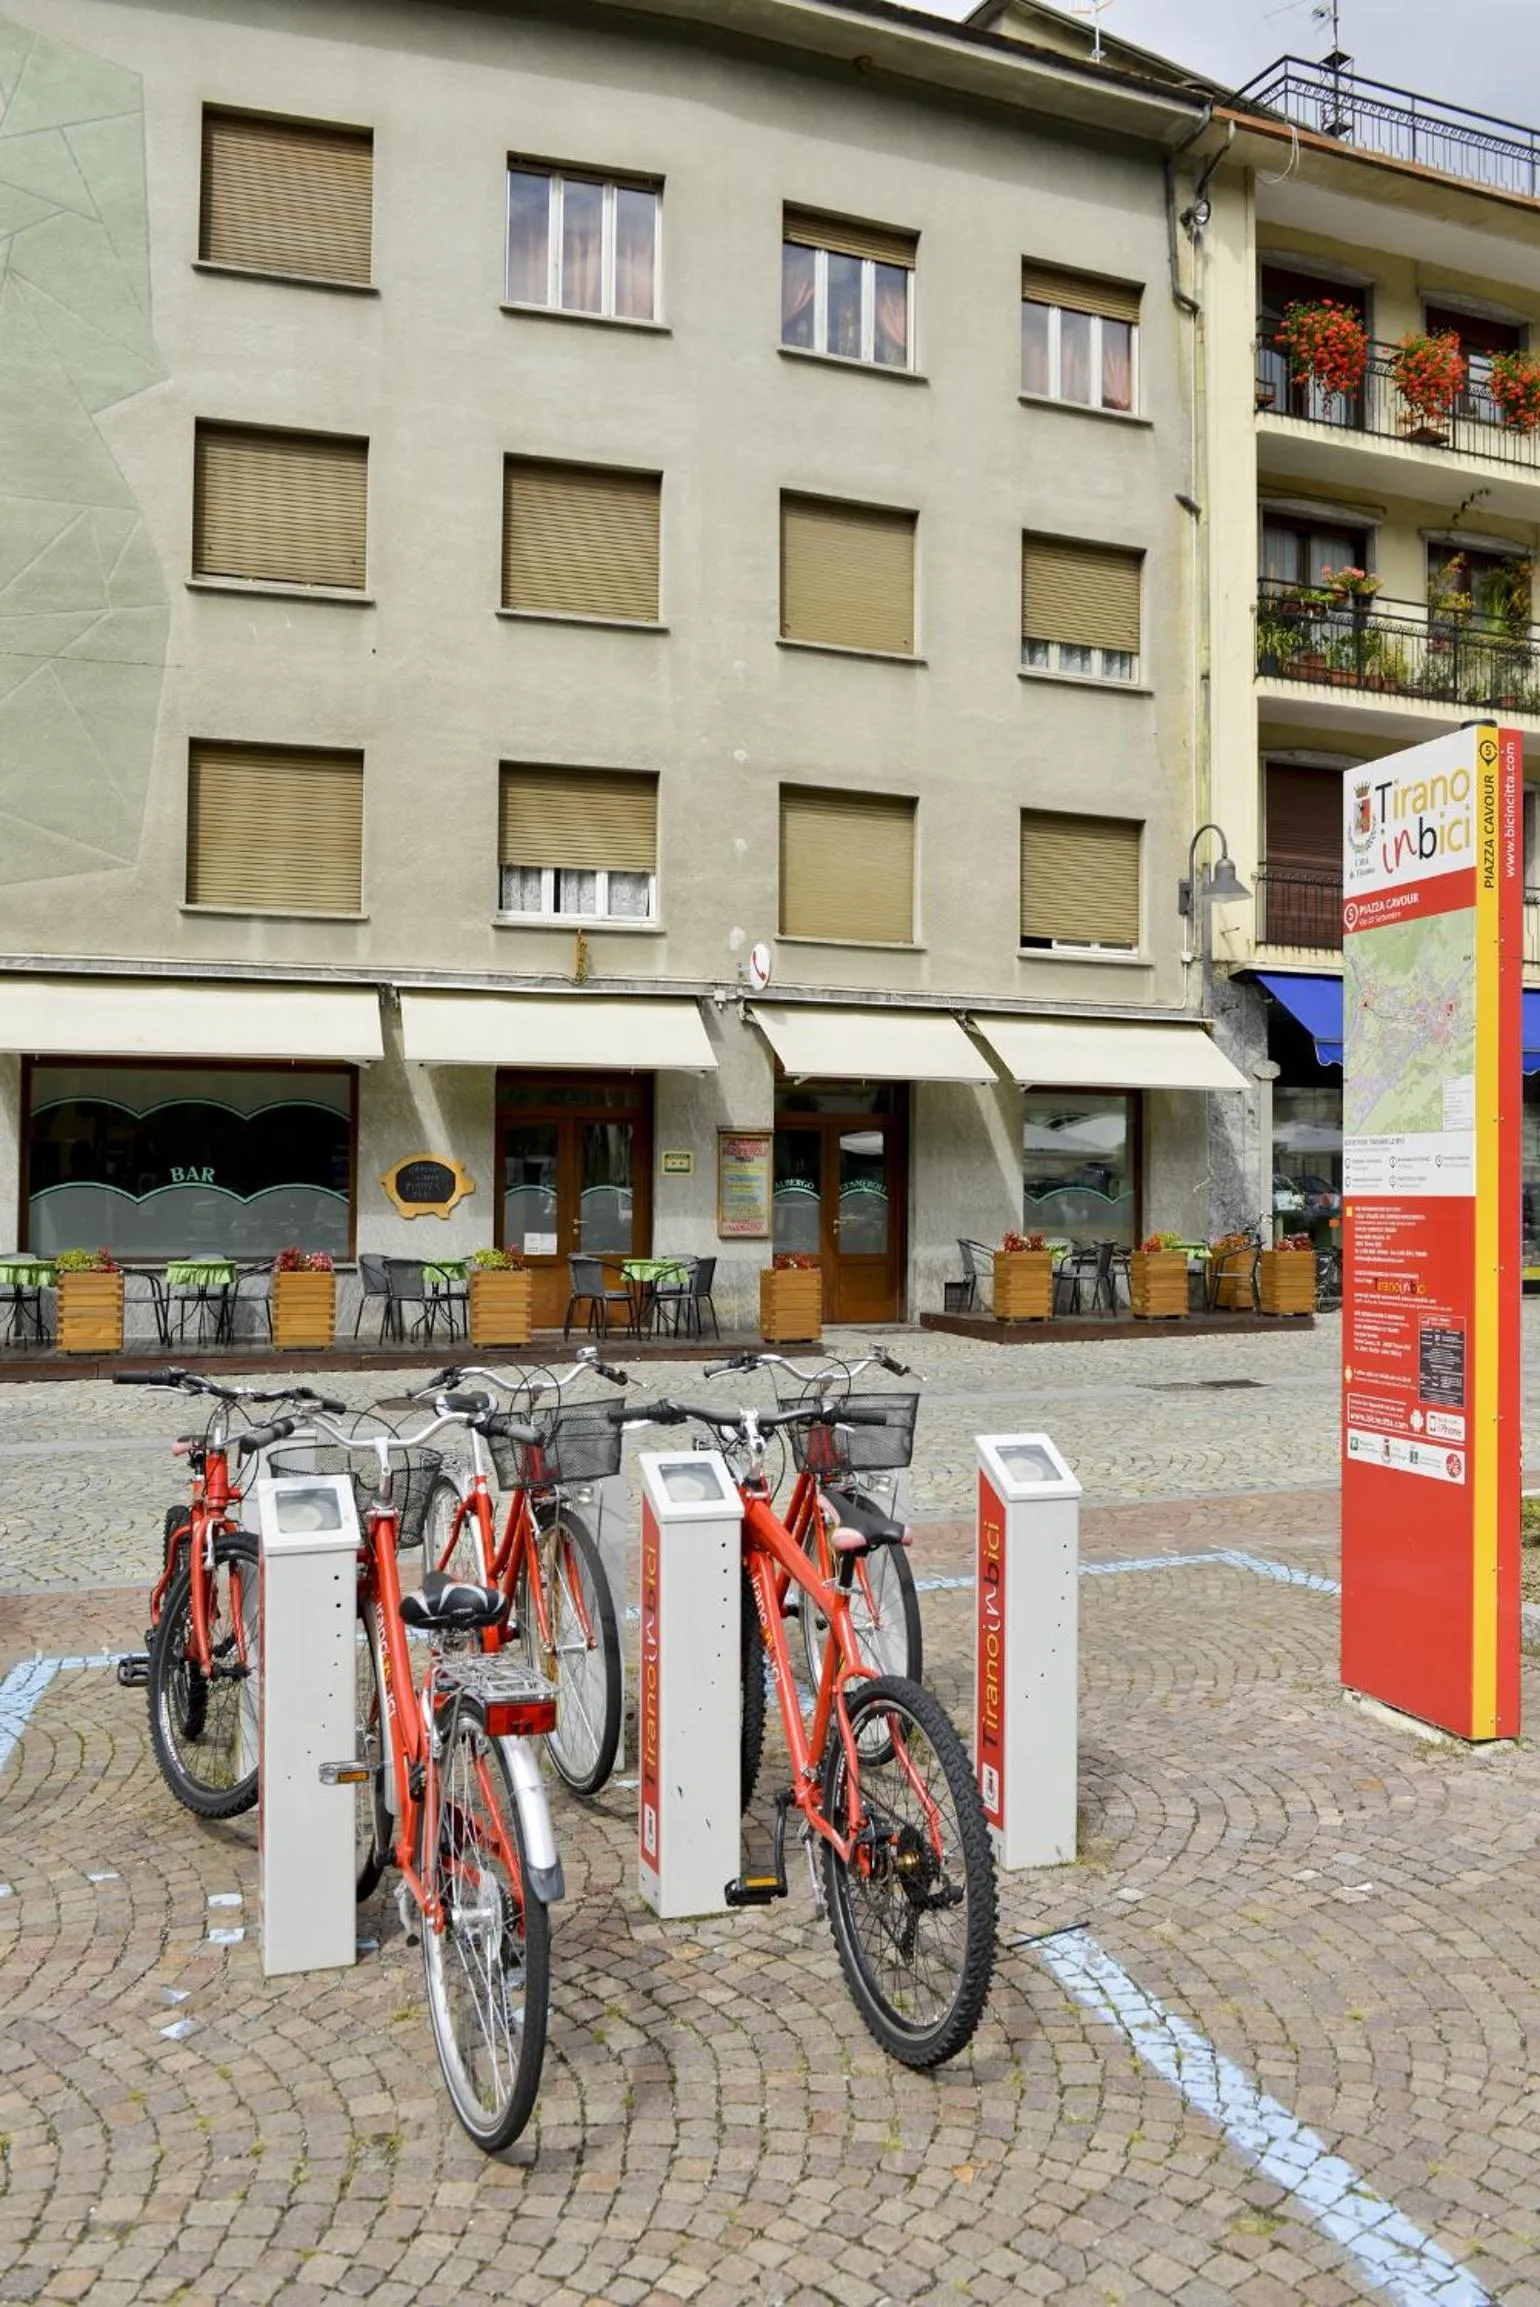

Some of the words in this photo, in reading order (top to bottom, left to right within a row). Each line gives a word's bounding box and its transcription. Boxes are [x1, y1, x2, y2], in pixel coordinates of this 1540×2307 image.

[1375, 768, 1470, 823] Tirano
[1484, 774, 1495, 835] CAVOUR
[1504, 742, 1516, 878] www.bicincitta.com
[1484, 838, 1495, 889] PIAZZA
[1359, 900, 1386, 915] PIAZZA
[1386, 892, 1420, 910] CAVOUR
[170, 1166, 215, 1183] BAR
